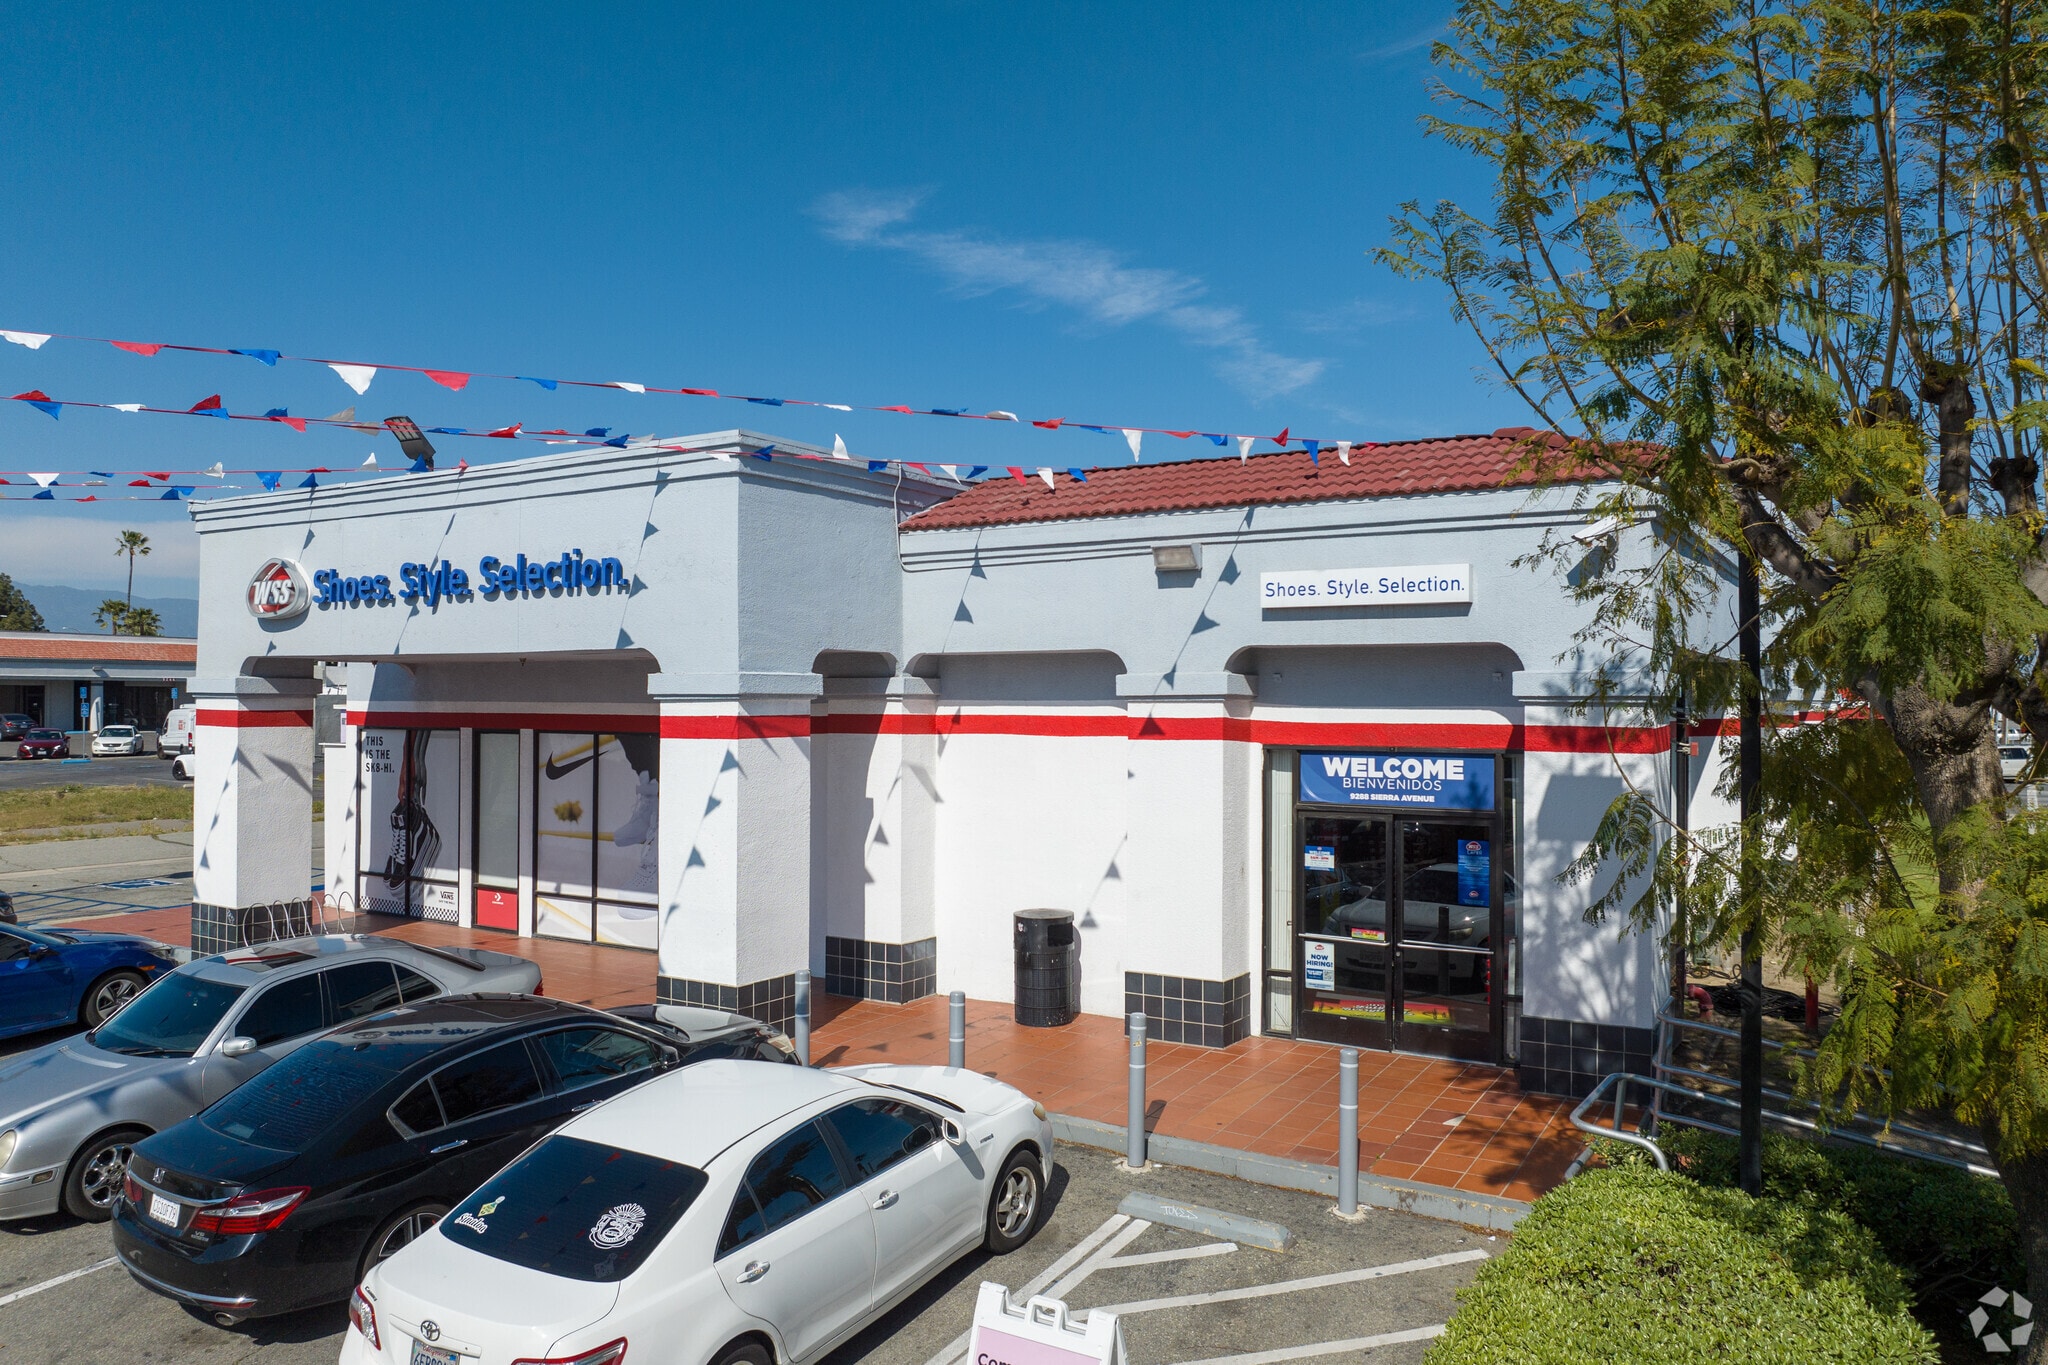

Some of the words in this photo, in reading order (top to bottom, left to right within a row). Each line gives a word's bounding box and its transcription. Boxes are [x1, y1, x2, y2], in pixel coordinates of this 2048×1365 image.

[312, 568, 395, 604] Shoes.
[399, 559, 474, 607] Style.
[478, 548, 631, 595] Selection.
[252, 579, 293, 605] WSS
[1265, 582, 1321, 597] Shoes.
[1327, 579, 1373, 598] Style.
[1378, 576, 1465, 593] Selection.
[366, 736, 384, 746] THIS
[365, 749, 374, 759] IS
[375, 749, 391, 760] THE
[365, 762, 395, 773] SK8-HI.
[1322, 756, 1465, 781] WELCOME
[1342, 777, 1442, 791] BIENVENIDOS
[1350, 792, 1370, 801] 9288
[1370, 793, 1400, 802] SIERRA
[1401, 795, 1435, 803] AVENUE
[1310, 953, 1329, 961] NOW
[1306, 960, 1333, 968] HIRING!
